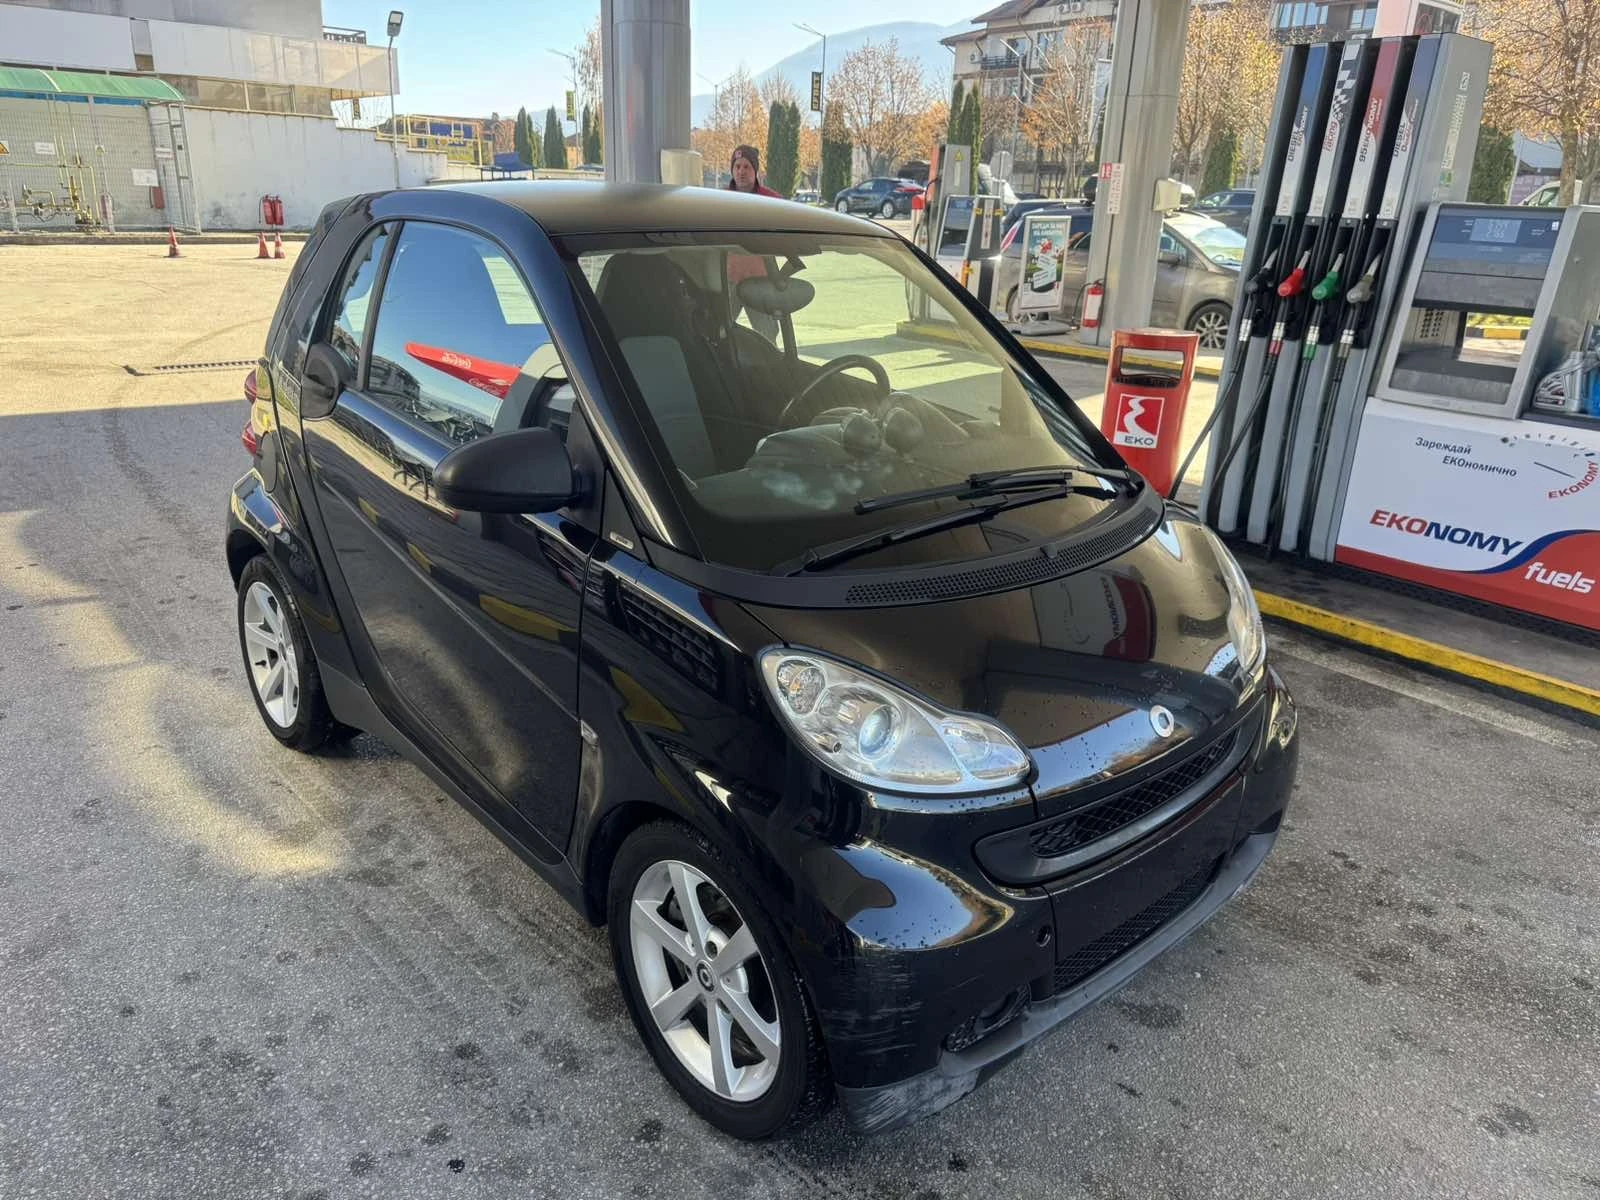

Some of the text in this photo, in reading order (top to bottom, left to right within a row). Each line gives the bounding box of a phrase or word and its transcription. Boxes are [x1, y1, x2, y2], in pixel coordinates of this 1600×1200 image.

[1287, 130, 1299, 162] DIESEL
[1393, 121, 1405, 158] DIESEL
[1124, 435, 1154, 446] EKO
[1415, 437, 1472, 455] Зареждай
[1442, 455, 1517, 477] ЕКОномично
[1548, 460, 1599, 499] EKONOMY
[1369, 509, 1523, 555] EKONOMY
[1524, 562, 1596, 594] fuels
